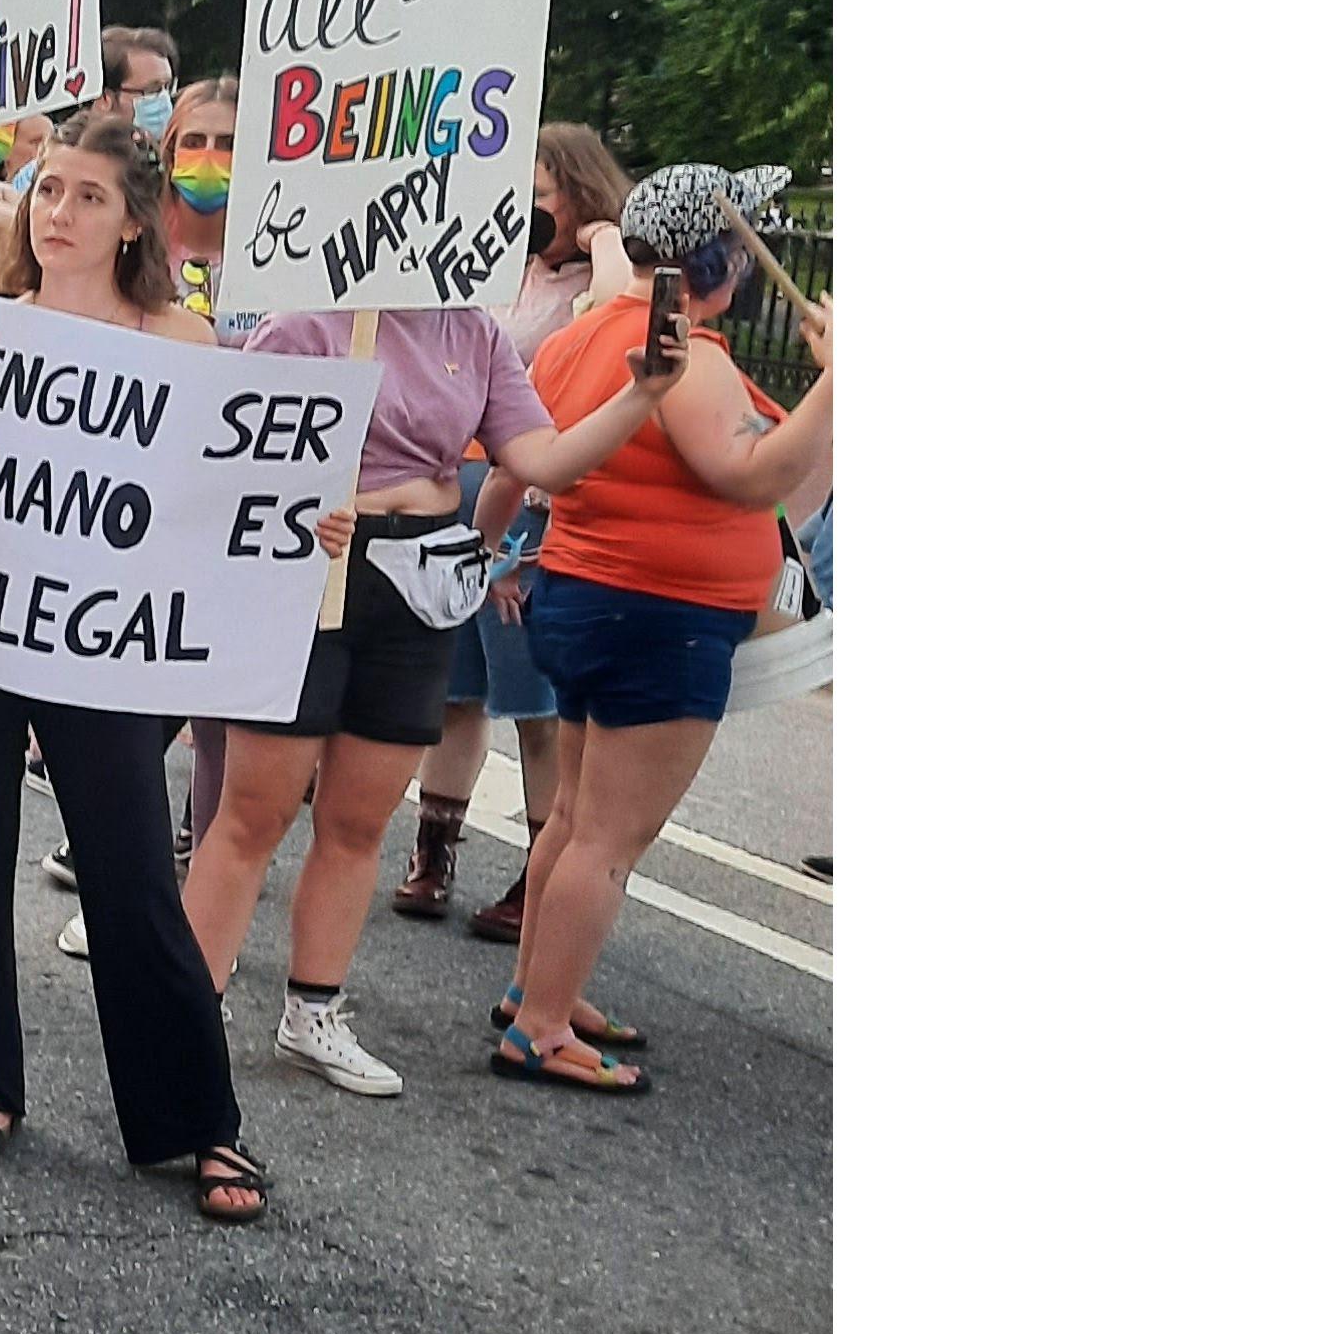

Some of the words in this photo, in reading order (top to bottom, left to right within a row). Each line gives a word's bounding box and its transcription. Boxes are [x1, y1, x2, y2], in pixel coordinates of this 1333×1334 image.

[267, 65, 516, 165] BEINGS
[245, 180, 311, 267] be
[321, 152, 452, 303] HAPPY
[425, 188, 528, 305] FREE
[202, 391, 343, 464] SER
[227, 494, 322, 560] ES
